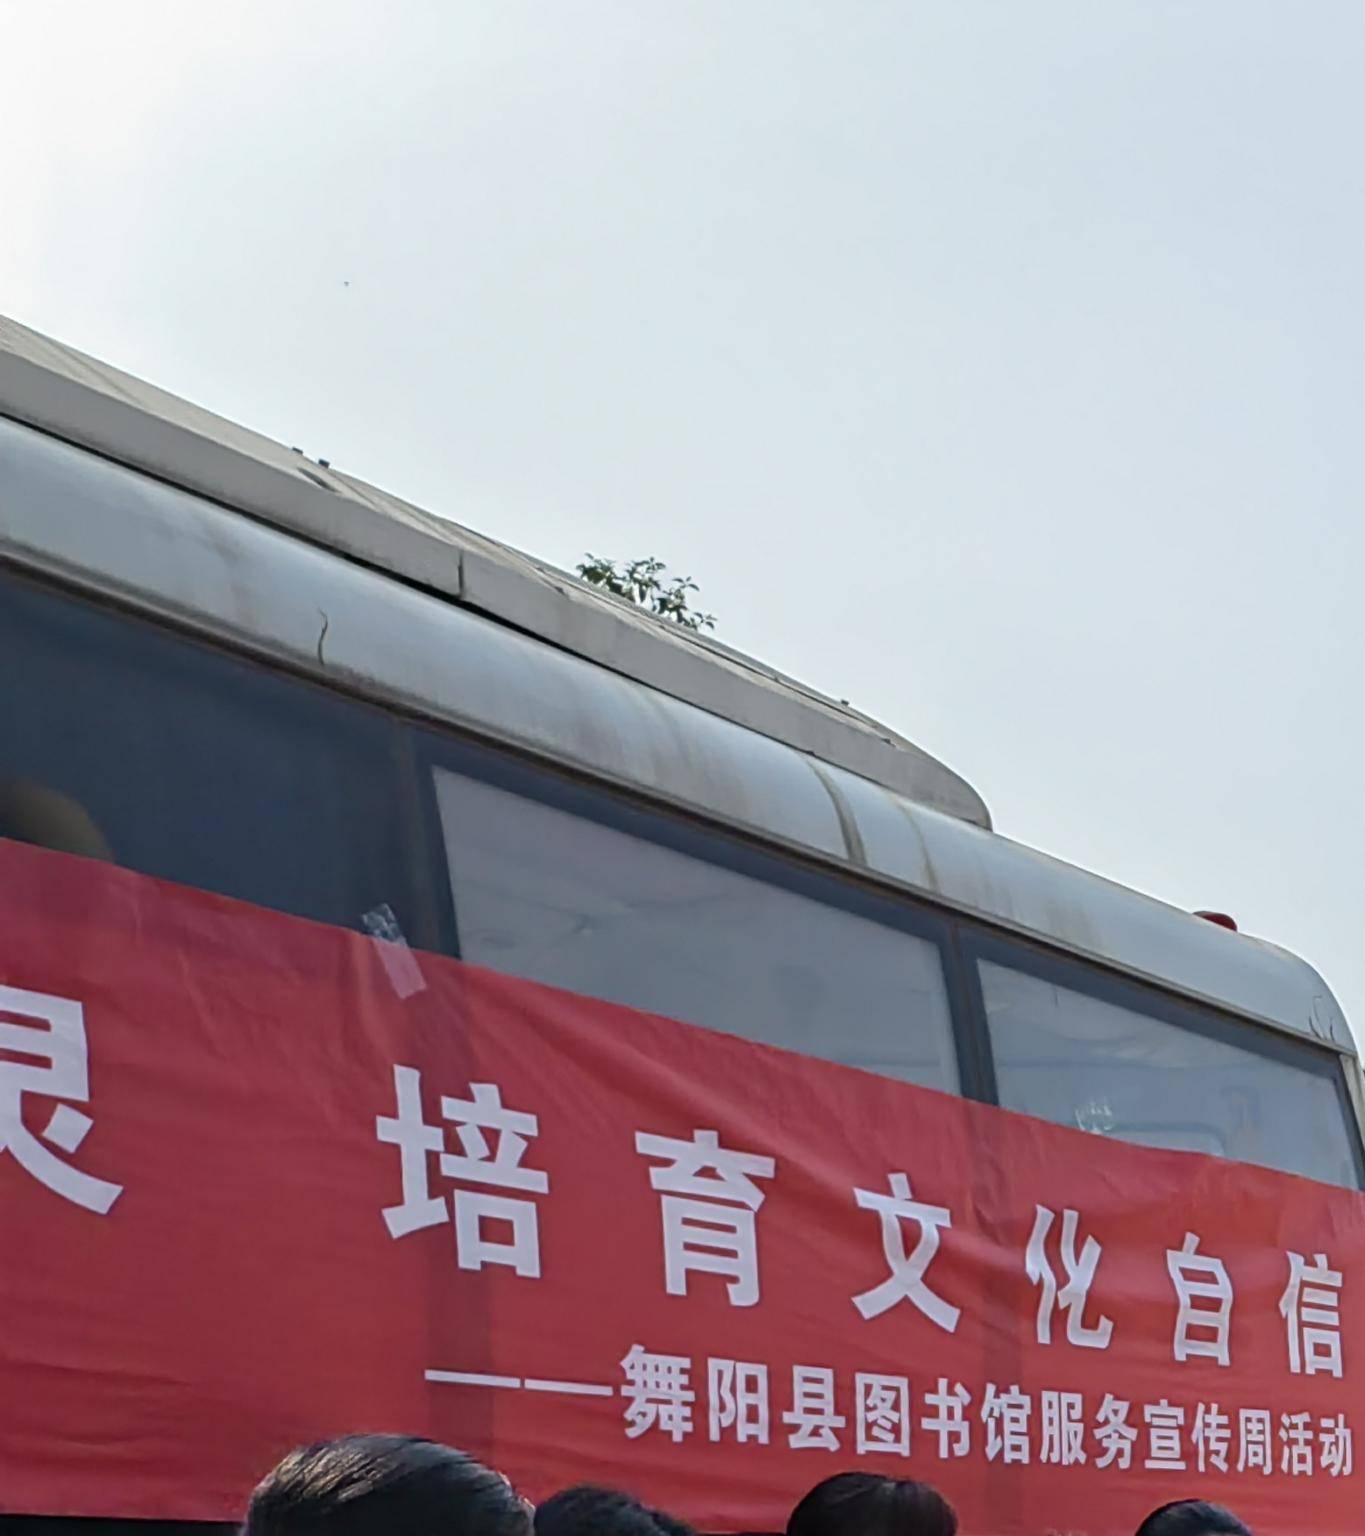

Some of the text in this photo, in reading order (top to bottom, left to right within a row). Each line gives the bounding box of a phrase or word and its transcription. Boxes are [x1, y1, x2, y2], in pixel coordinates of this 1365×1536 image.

[376, 1064, 1344, 1379] 培育文化自信
